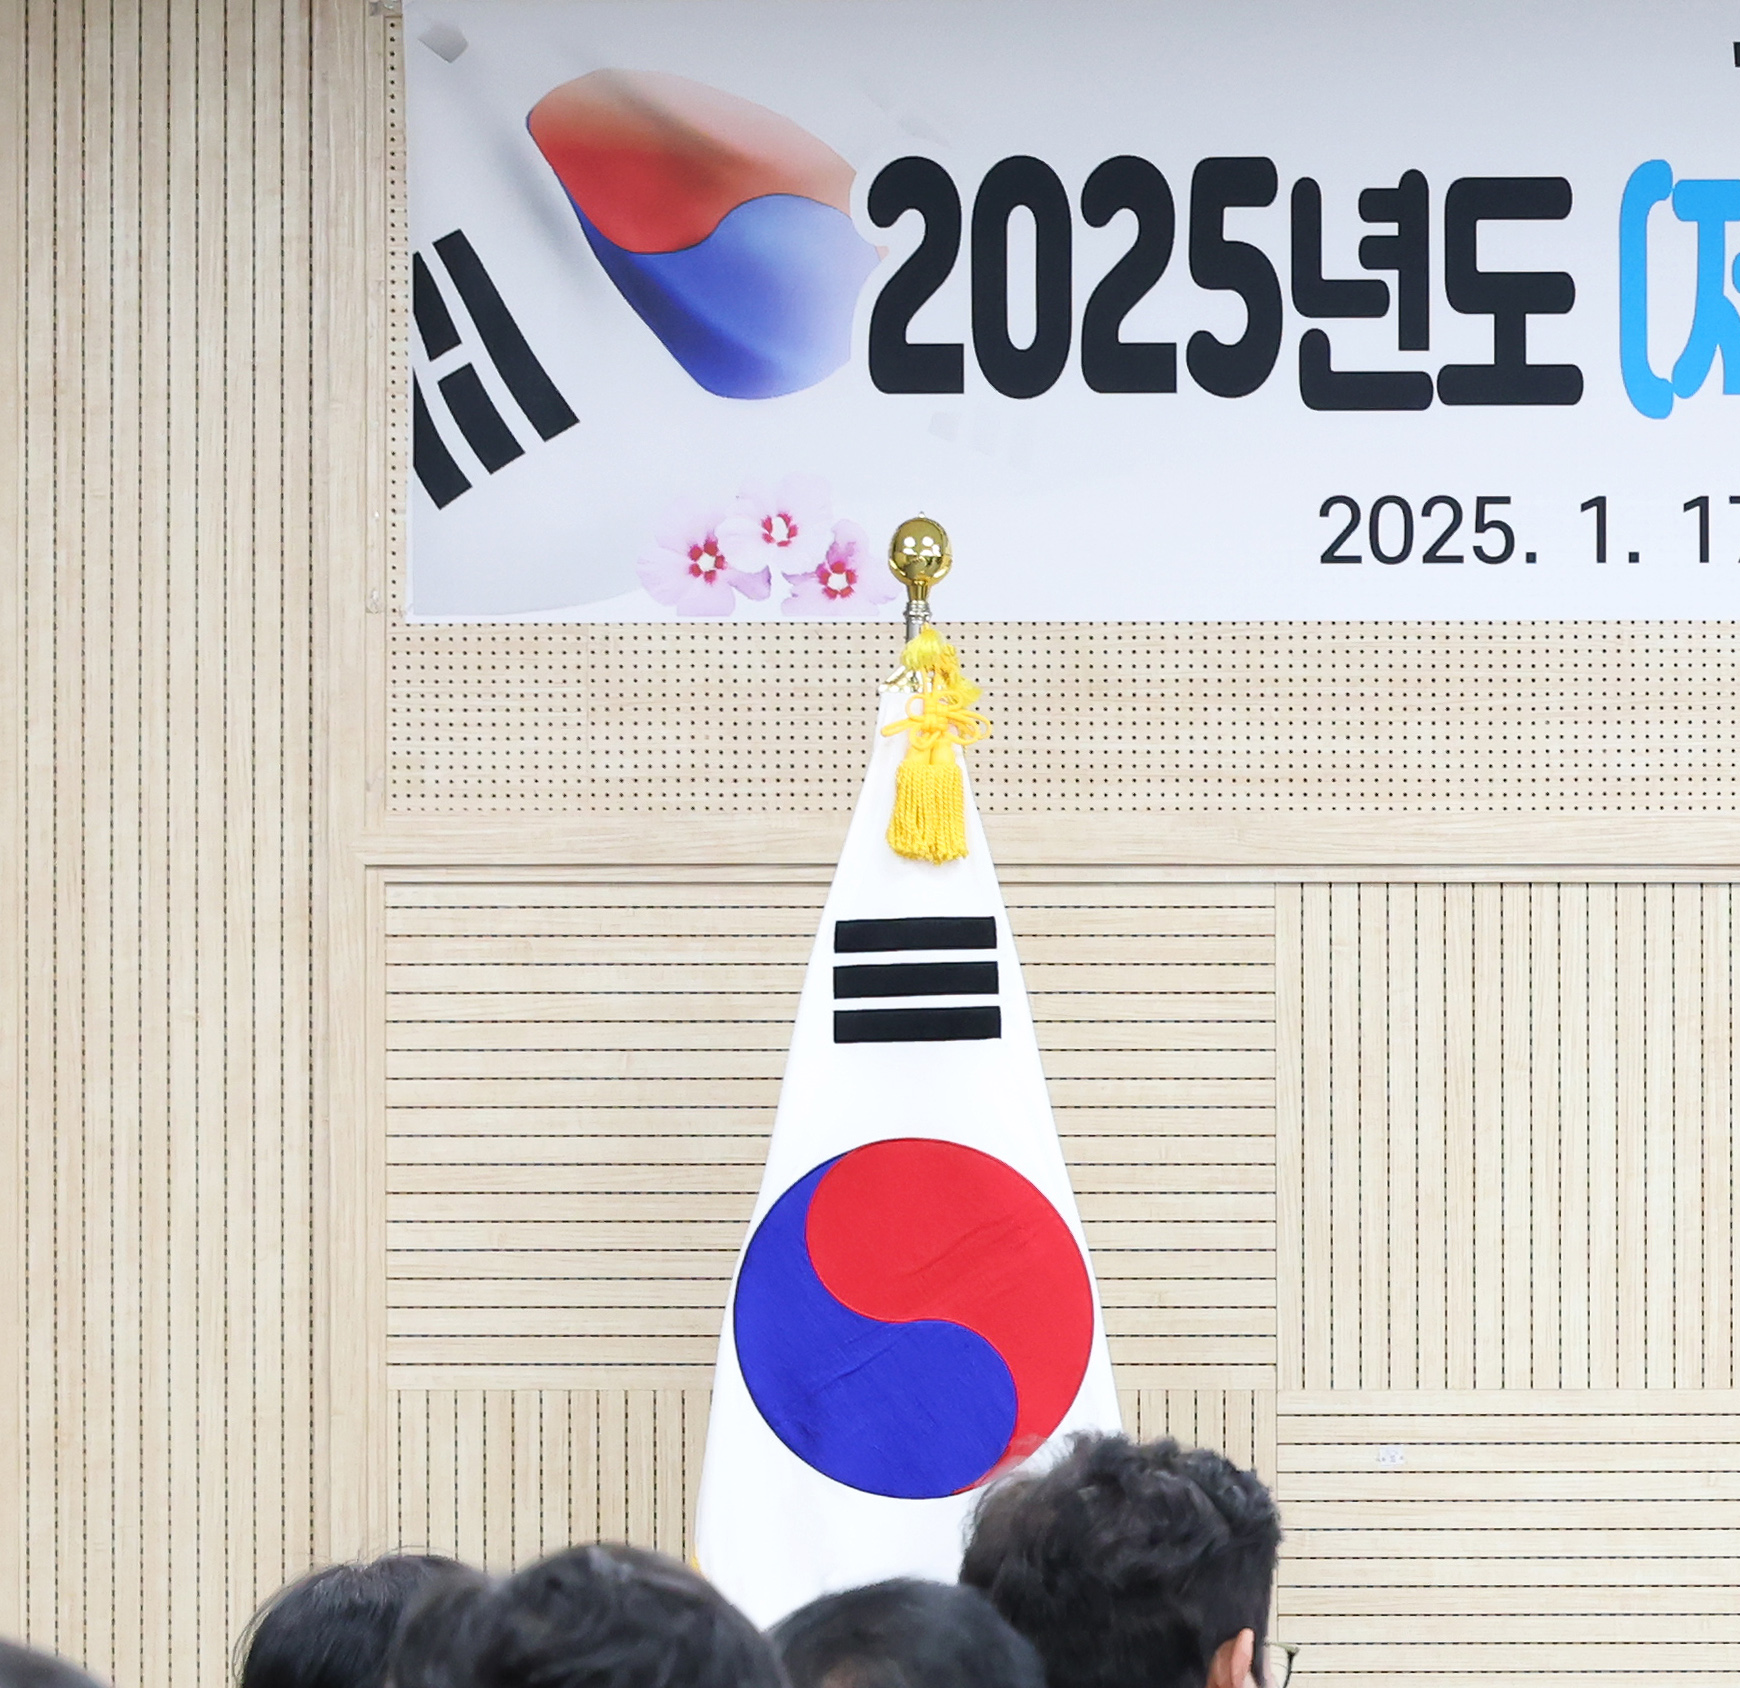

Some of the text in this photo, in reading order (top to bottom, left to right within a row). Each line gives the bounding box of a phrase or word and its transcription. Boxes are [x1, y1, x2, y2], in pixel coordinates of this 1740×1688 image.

[866, 154, 1585, 412] 2025년도
[1318, 494, 1537, 566] 2025.
[1580, 495, 1640, 564] 1.
